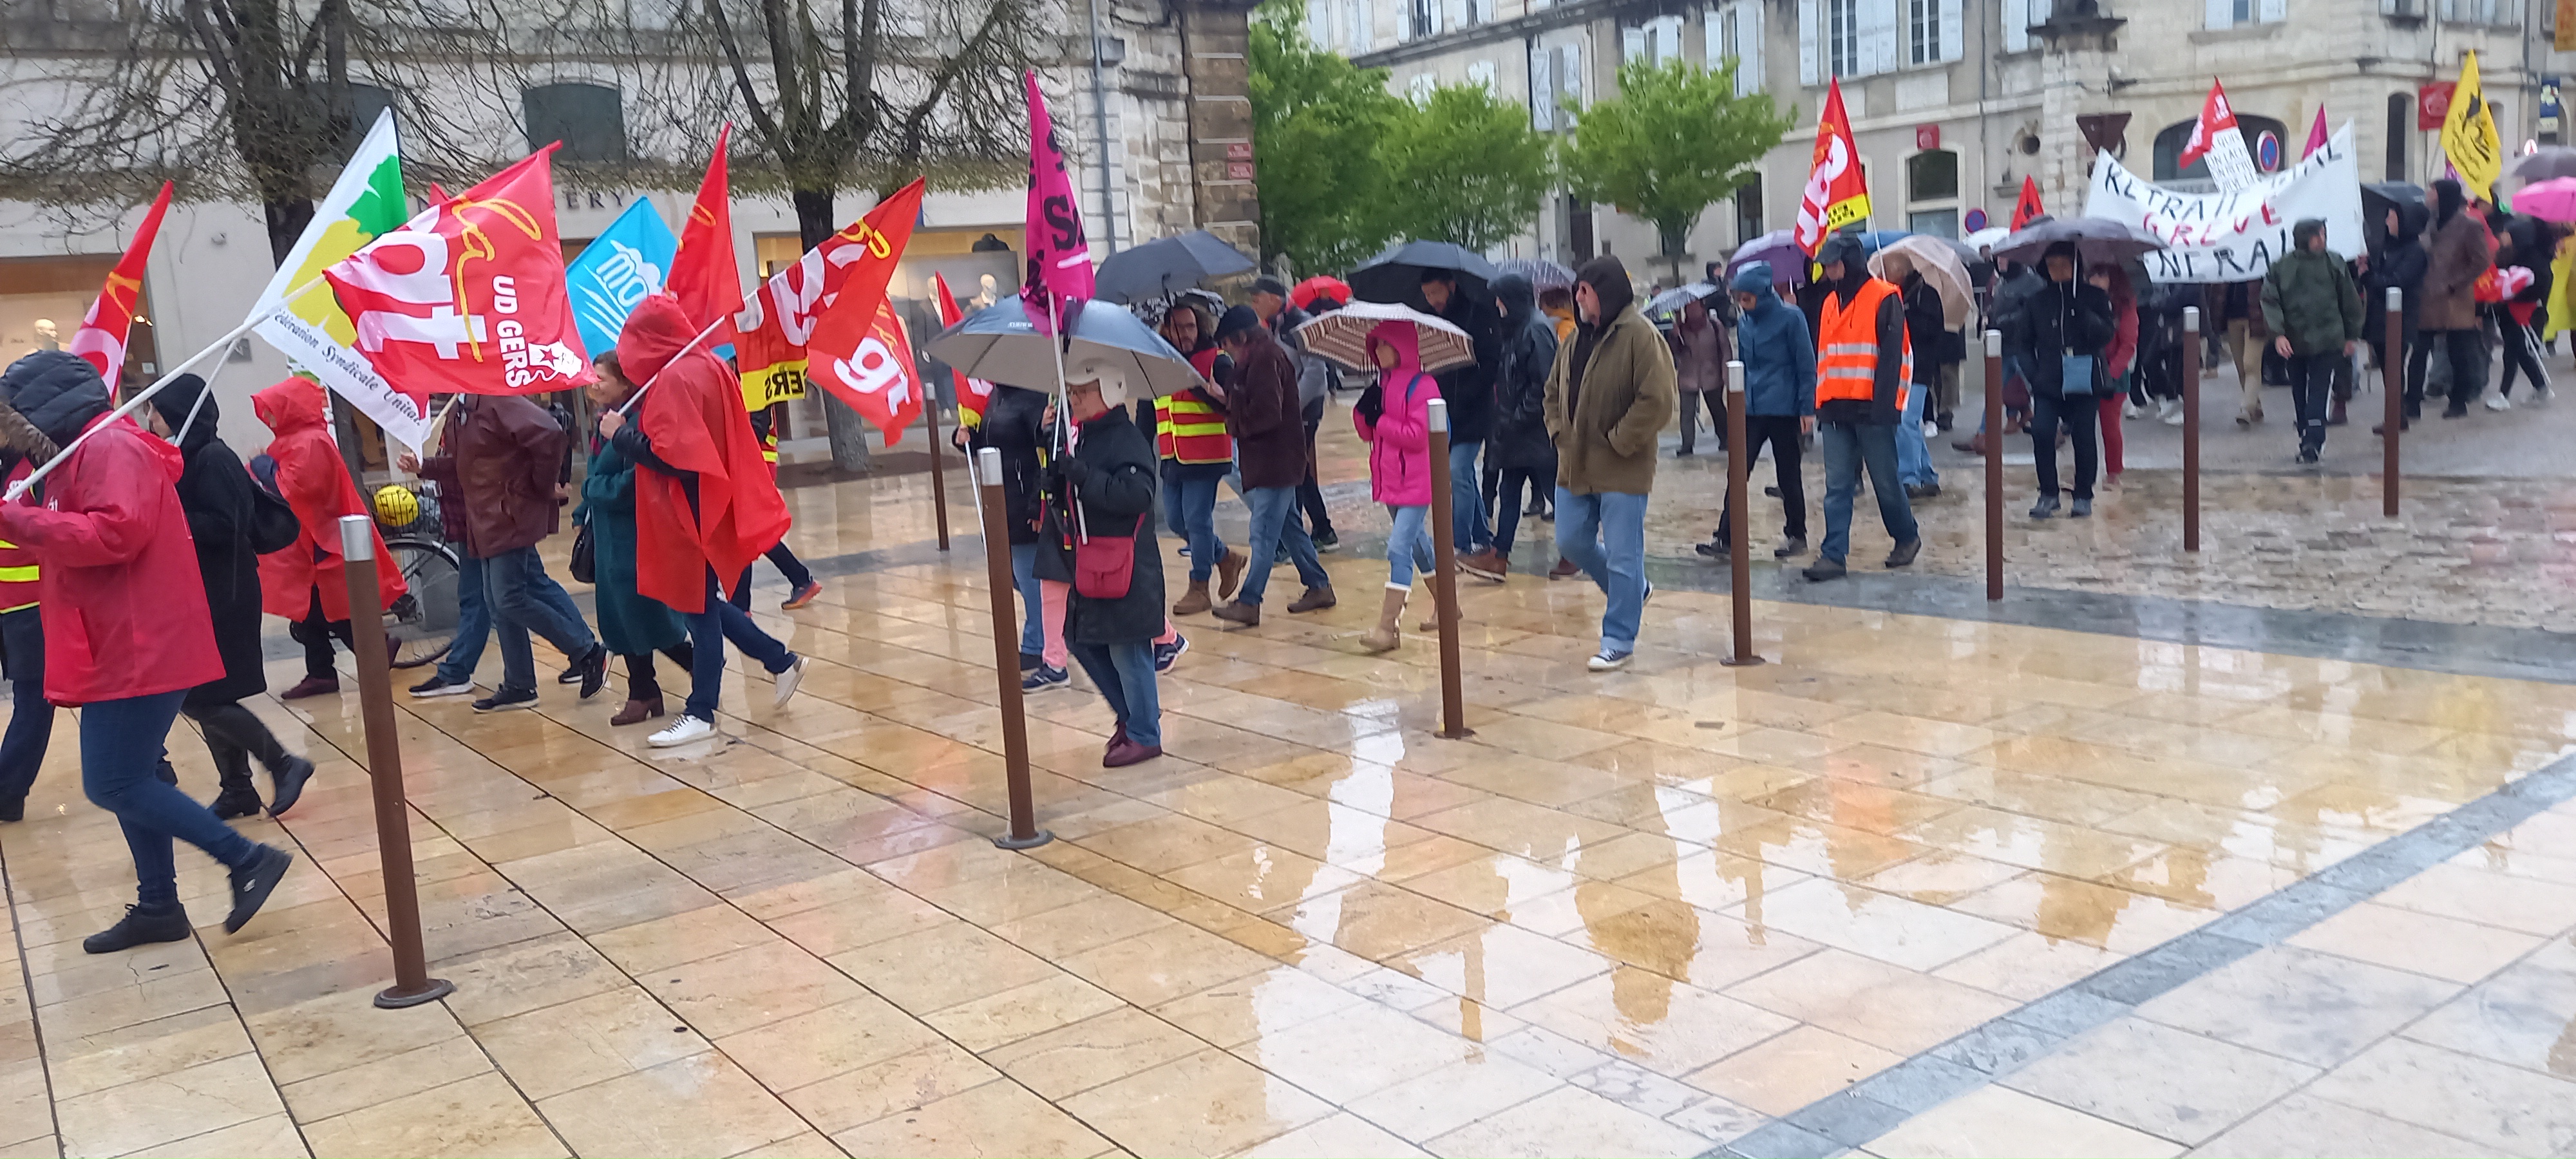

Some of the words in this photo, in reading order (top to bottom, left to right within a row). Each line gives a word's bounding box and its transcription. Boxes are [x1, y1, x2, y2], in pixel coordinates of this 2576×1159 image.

[325, 204, 488, 360] gt
[493, 275, 518, 314] UD
[275, 308, 319, 348] édération
[321, 344, 379, 391] Syndicale
[497, 320, 531, 388] GERS
